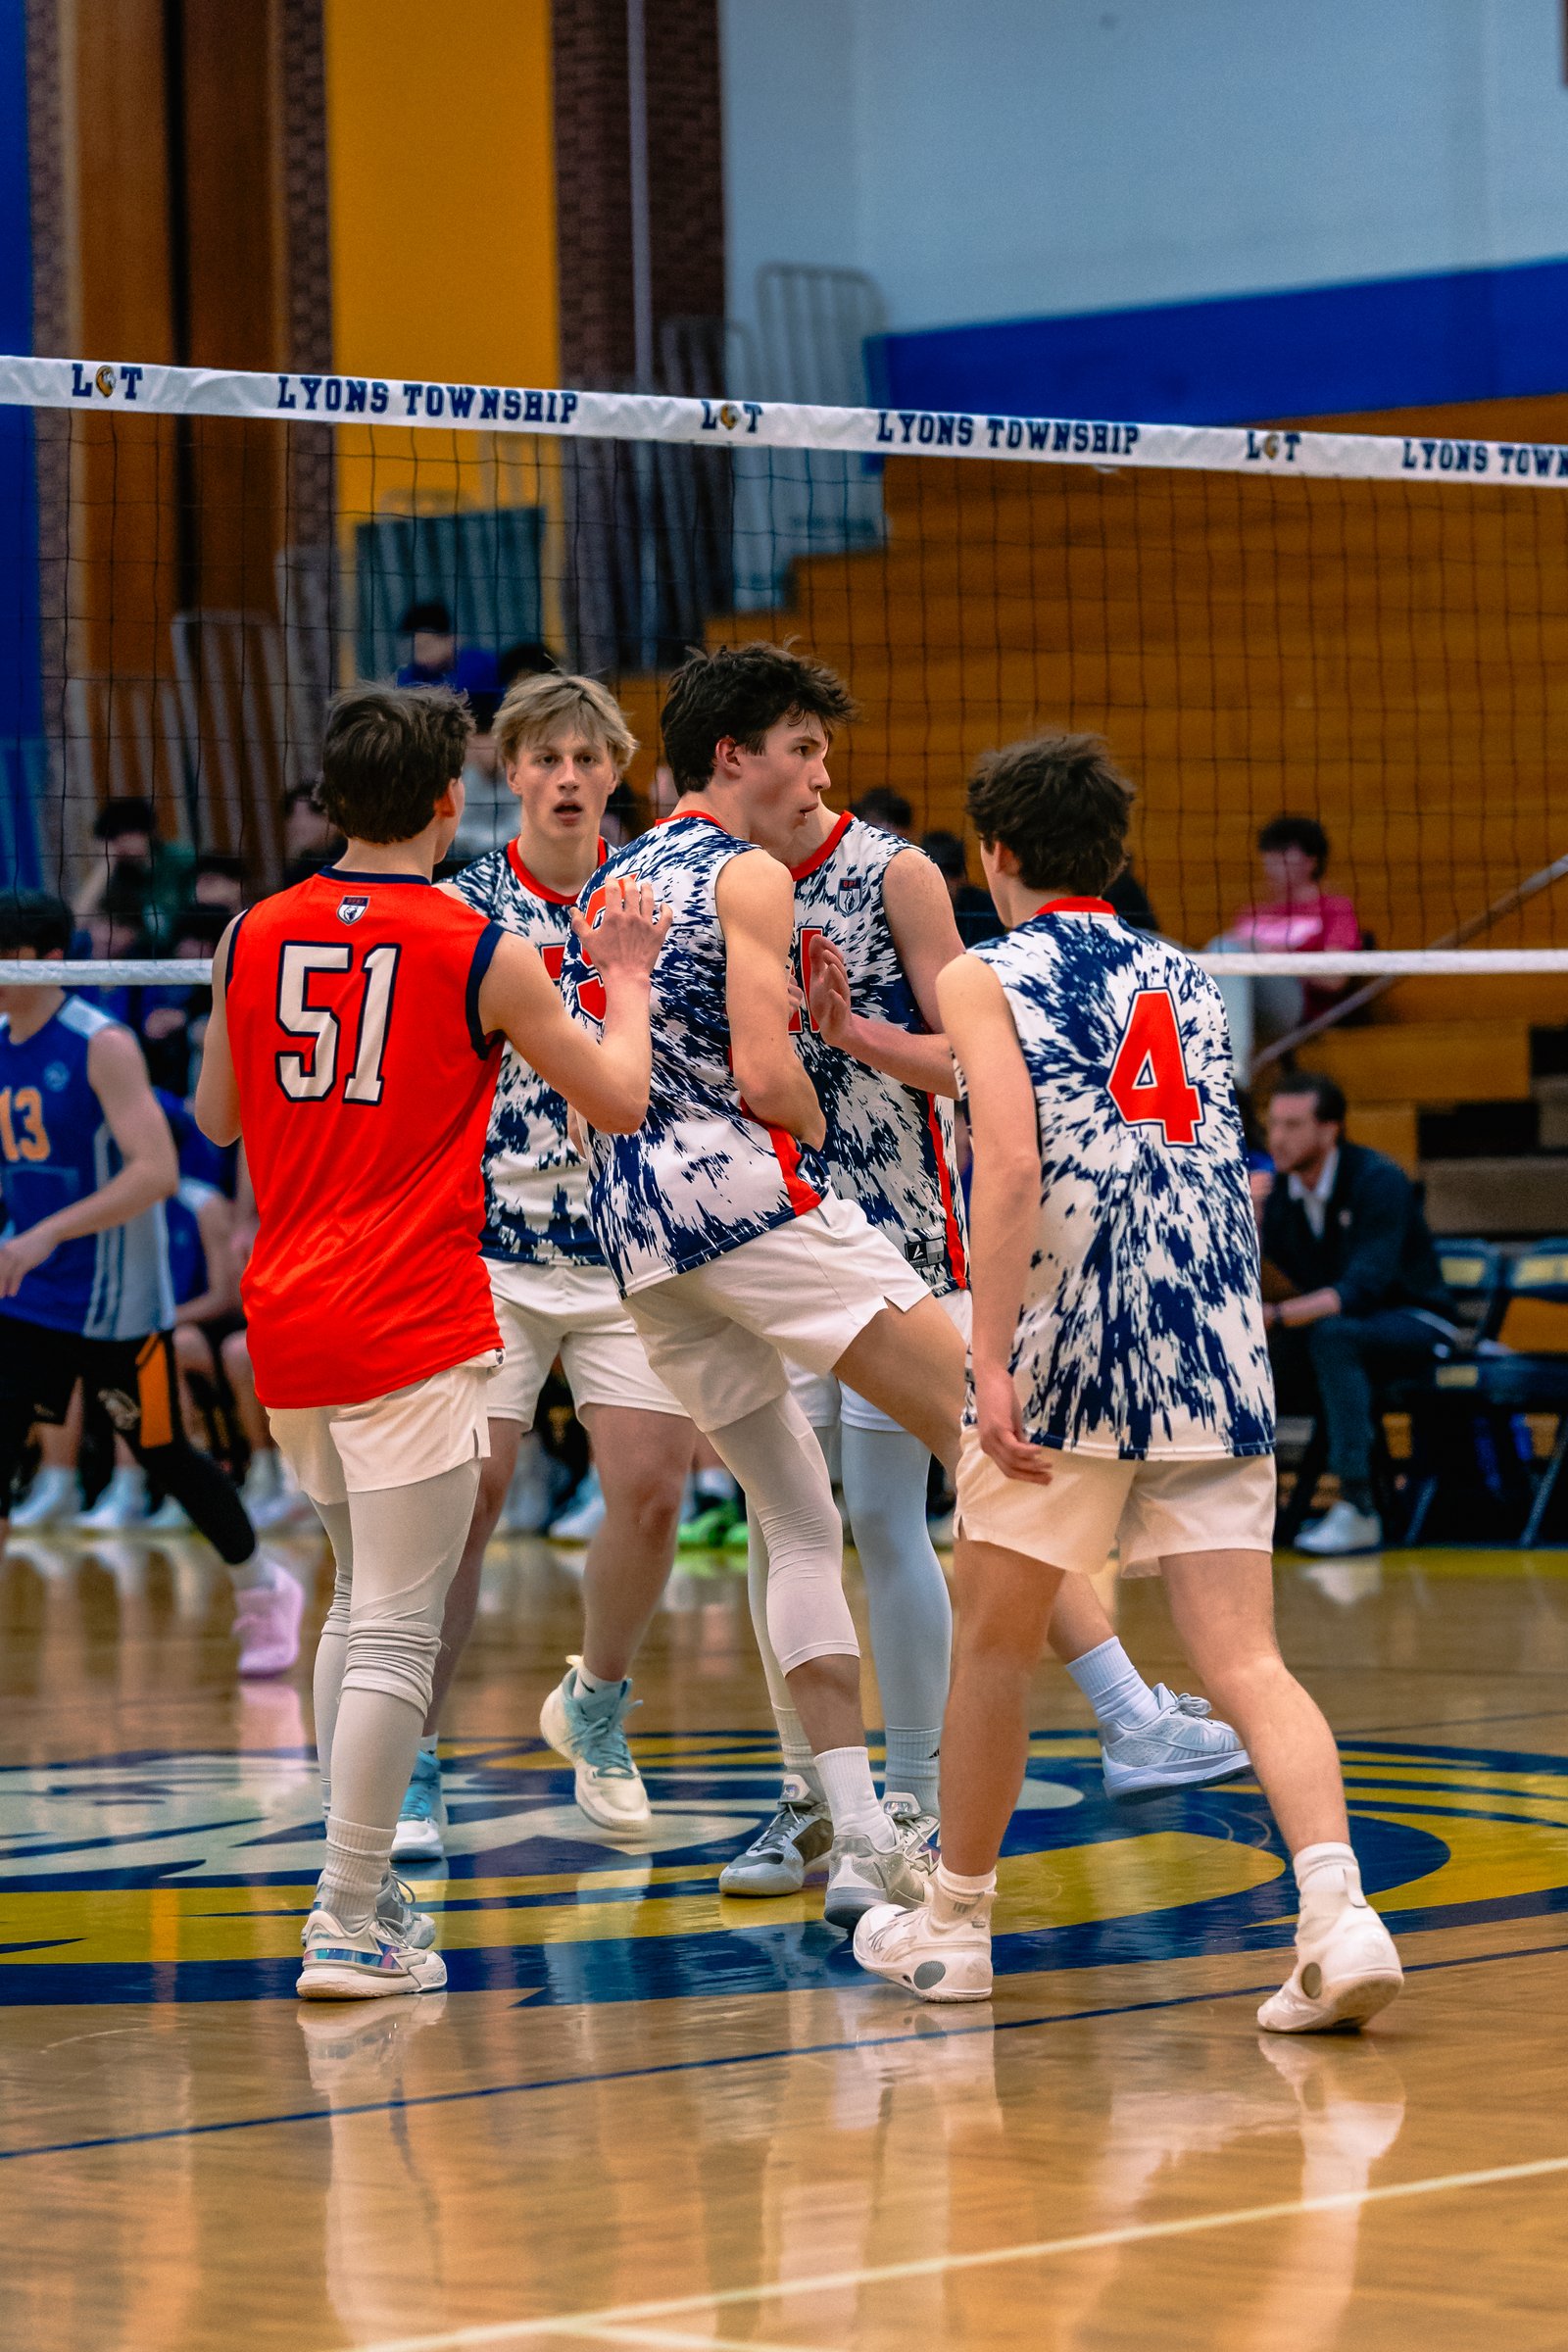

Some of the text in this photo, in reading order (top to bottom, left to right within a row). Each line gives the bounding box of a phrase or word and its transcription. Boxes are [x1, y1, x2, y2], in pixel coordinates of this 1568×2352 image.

[277, 375, 578, 424] LYONS TOWNSHIP
[876, 411, 1140, 456] LYONS TOWNSHIP
[1402, 440, 1489, 473] LYONS
[275, 940, 402, 1107] 51
[1106, 986, 1206, 1148] 4
[0, 1086, 51, 1162] 13
